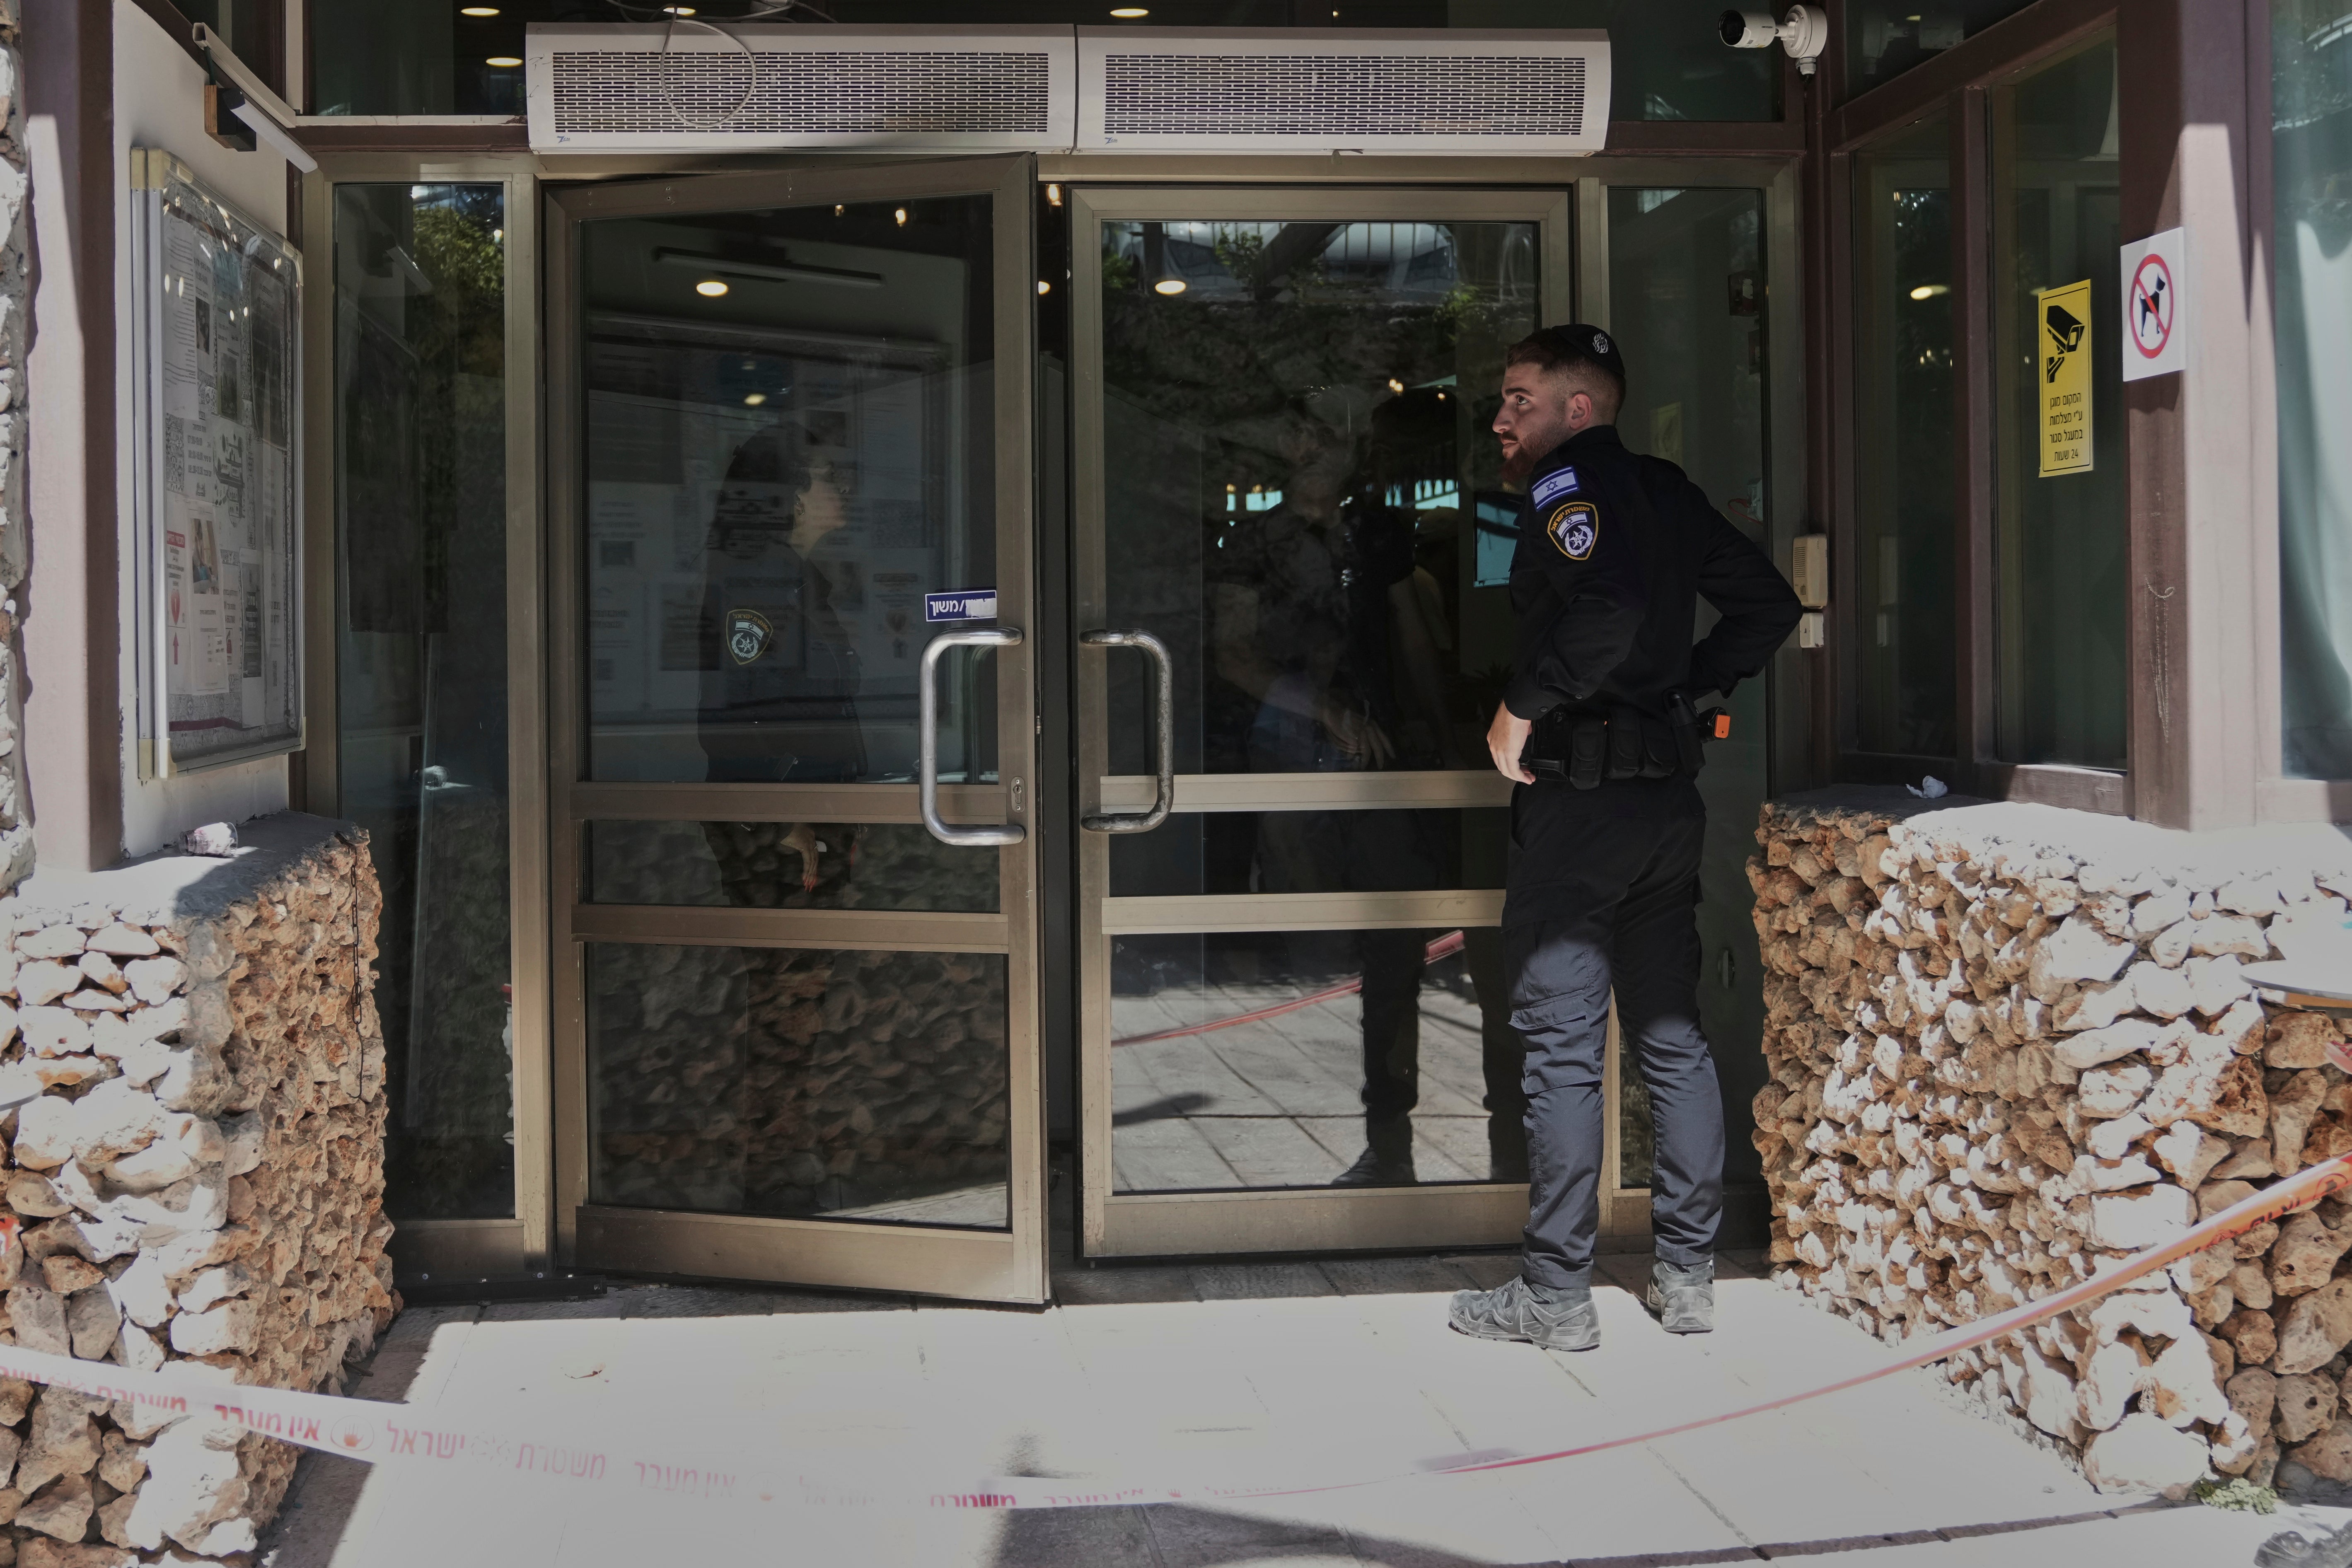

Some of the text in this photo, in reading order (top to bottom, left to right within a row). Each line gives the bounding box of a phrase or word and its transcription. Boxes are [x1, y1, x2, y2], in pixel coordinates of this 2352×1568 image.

[2050, 393, 2081, 410] המקום מוגן
[2049, 412, 2071, 426] מצלמות
[2050, 429, 2083, 444] במעגל סגור
[2054, 449, 2078, 461] 24 שעות
[1551, 506, 1590, 532] משטרת ישראל
[288, 1417, 321, 1441] אין
[386, 1419, 606, 1480] משטרת ישראל
[634, 1461, 736, 1499] אין מעבר
